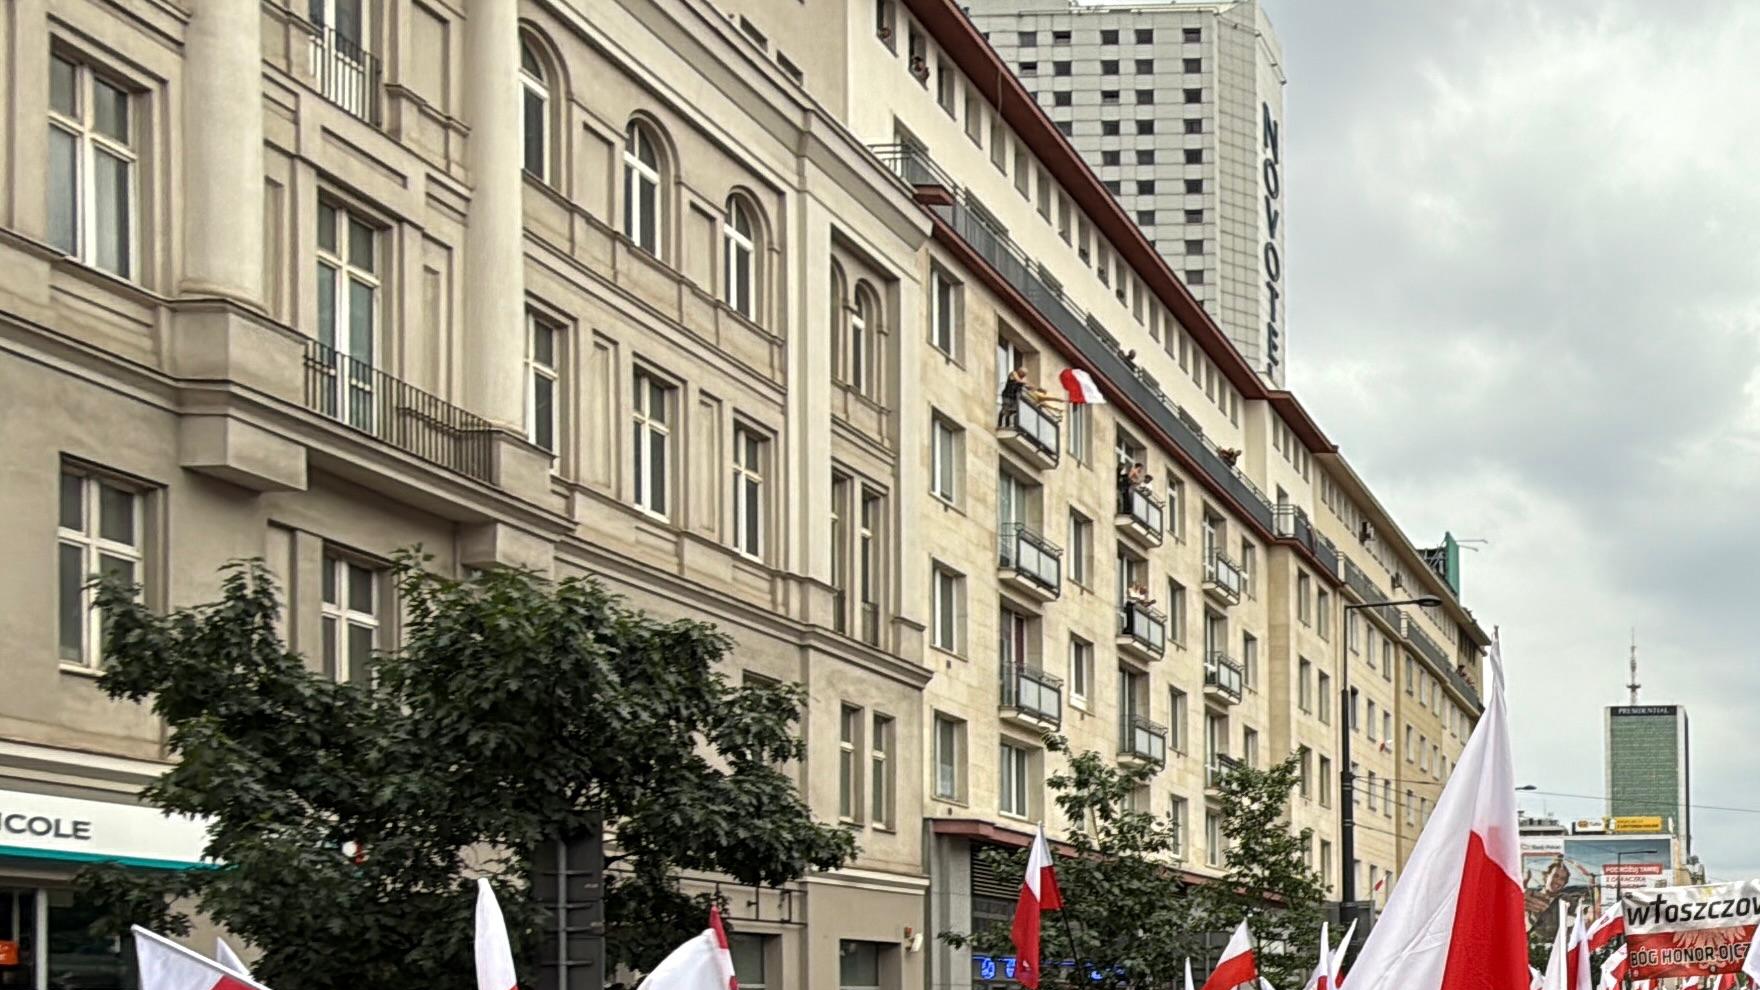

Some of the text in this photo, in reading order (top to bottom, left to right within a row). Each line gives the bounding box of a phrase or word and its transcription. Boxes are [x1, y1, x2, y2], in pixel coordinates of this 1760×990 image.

[0, 812, 91, 840] COLE
[1631, 942, 1751, 967] BÓG HONOR OJCZ
